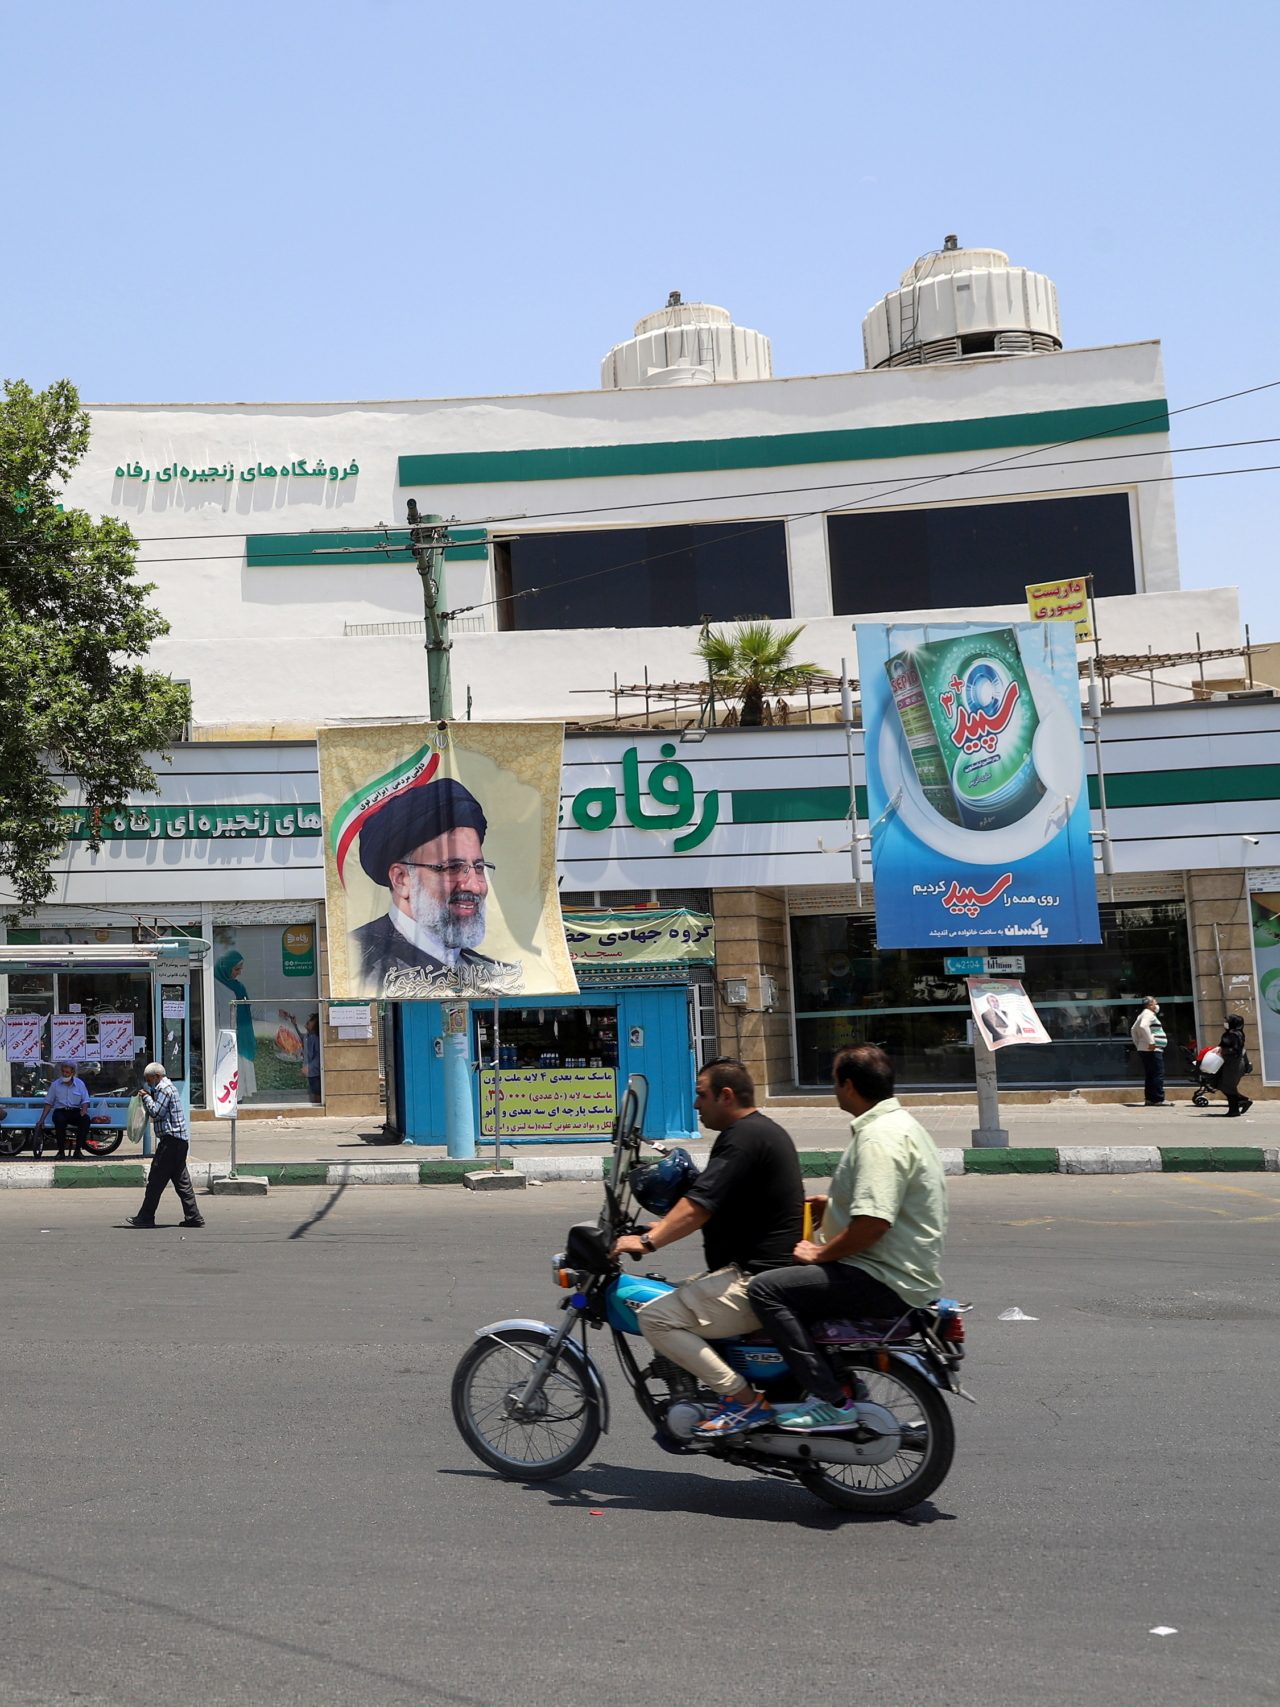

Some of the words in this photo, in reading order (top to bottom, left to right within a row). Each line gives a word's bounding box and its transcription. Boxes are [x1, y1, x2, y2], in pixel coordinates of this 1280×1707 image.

[115, 461, 150, 483] رفاه
[892, 671, 918, 693] SEPID
[951, 681, 1020, 752] سپید
[392, 775, 411, 790] مردمی
[372, 787, 389, 803] ایرانی
[572, 743, 719, 853] رفاه
[360, 799, 371, 811] قوی
[113, 806, 161, 838] رفاه
[912, 881, 947, 895] کردیم
[941, 872, 1013, 918] سپید
[1003, 893, 1011, 906] را
[1012, 894, 1036, 904] همه
[1037, 895, 1060, 906] روی
[928, 929, 948, 937] اندیشد
[958, 929, 978, 937] خانواده
[1004, 918, 1049, 938] یاکسان
[598, 928, 662, 947] جهادی
[581, 951, 623, 960] مسجد
[524, 1073, 538, 1083] لایه
[540, 1072, 547, 1081] ۴
[549, 1074, 572, 1083] بعدی
[587, 1072, 612, 1081] ماسک
[568, 1092, 580, 1100] لایه
[593, 1091, 612, 1099] ماسک
[508, 1107, 532, 1118] بعدی
[547, 1106, 560, 1117] ای
[588, 1106, 613, 1114] ماسک
[583, 1121, 595, 1131] مواد
